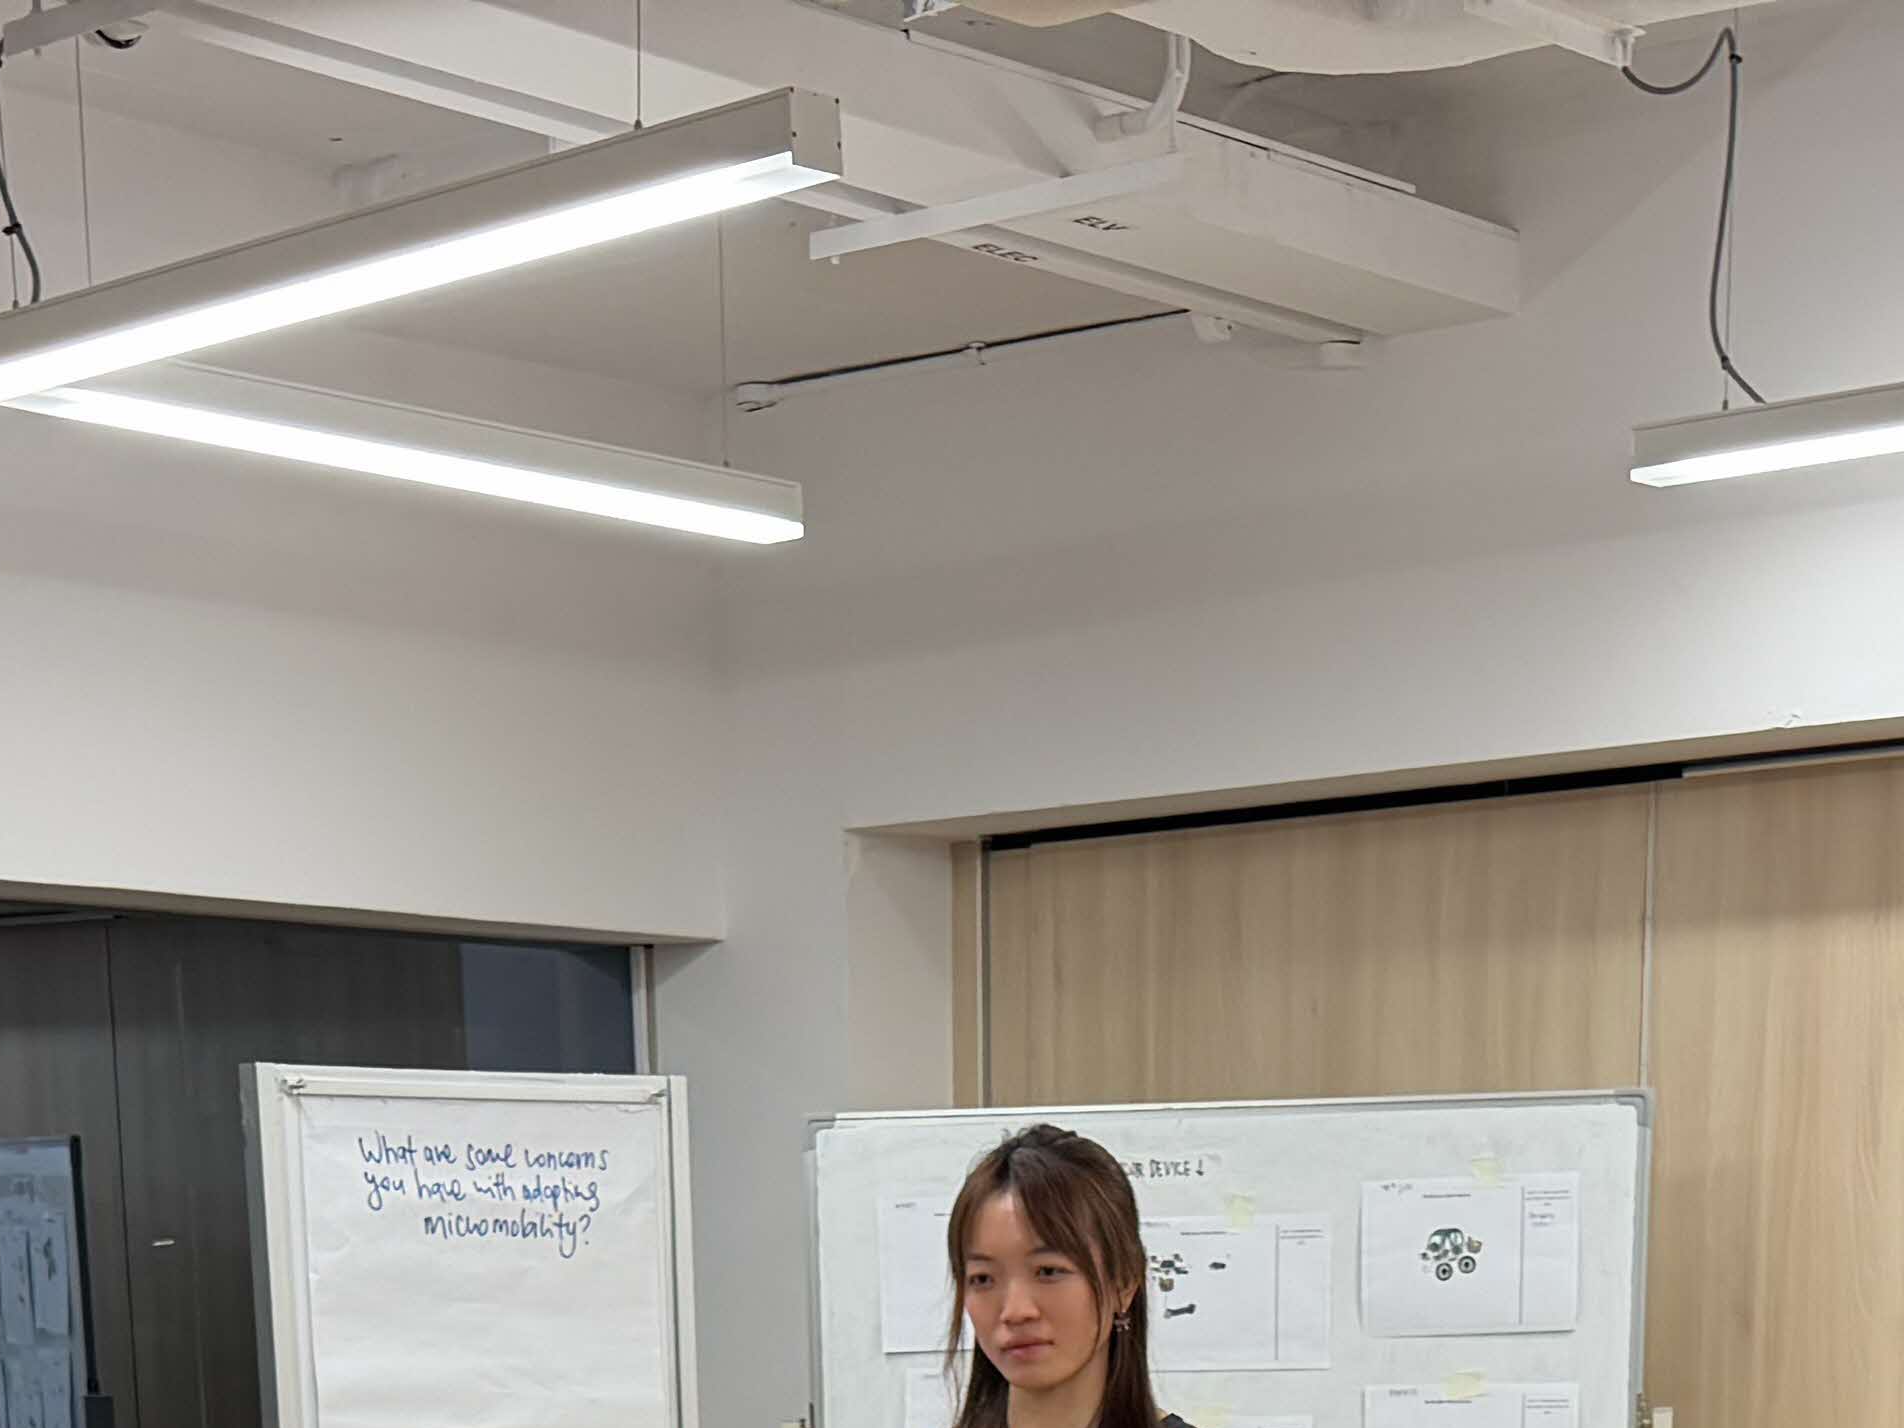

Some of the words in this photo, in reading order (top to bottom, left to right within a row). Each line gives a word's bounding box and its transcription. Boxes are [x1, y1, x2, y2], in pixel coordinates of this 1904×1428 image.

[359, 1130, 417, 1165] What
[425, 1145, 457, 1165] are
[467, 1143, 516, 1170] some
[525, 1149, 608, 1170] concerns
[1149, 1159, 1190, 1178] DEVICE
[364, 1172, 405, 1210] you
[415, 1169, 465, 1201] have
[474, 1174, 515, 1200] with
[523, 1175, 599, 1211] adopting
[425, 1209, 591, 1258] micromobility?
